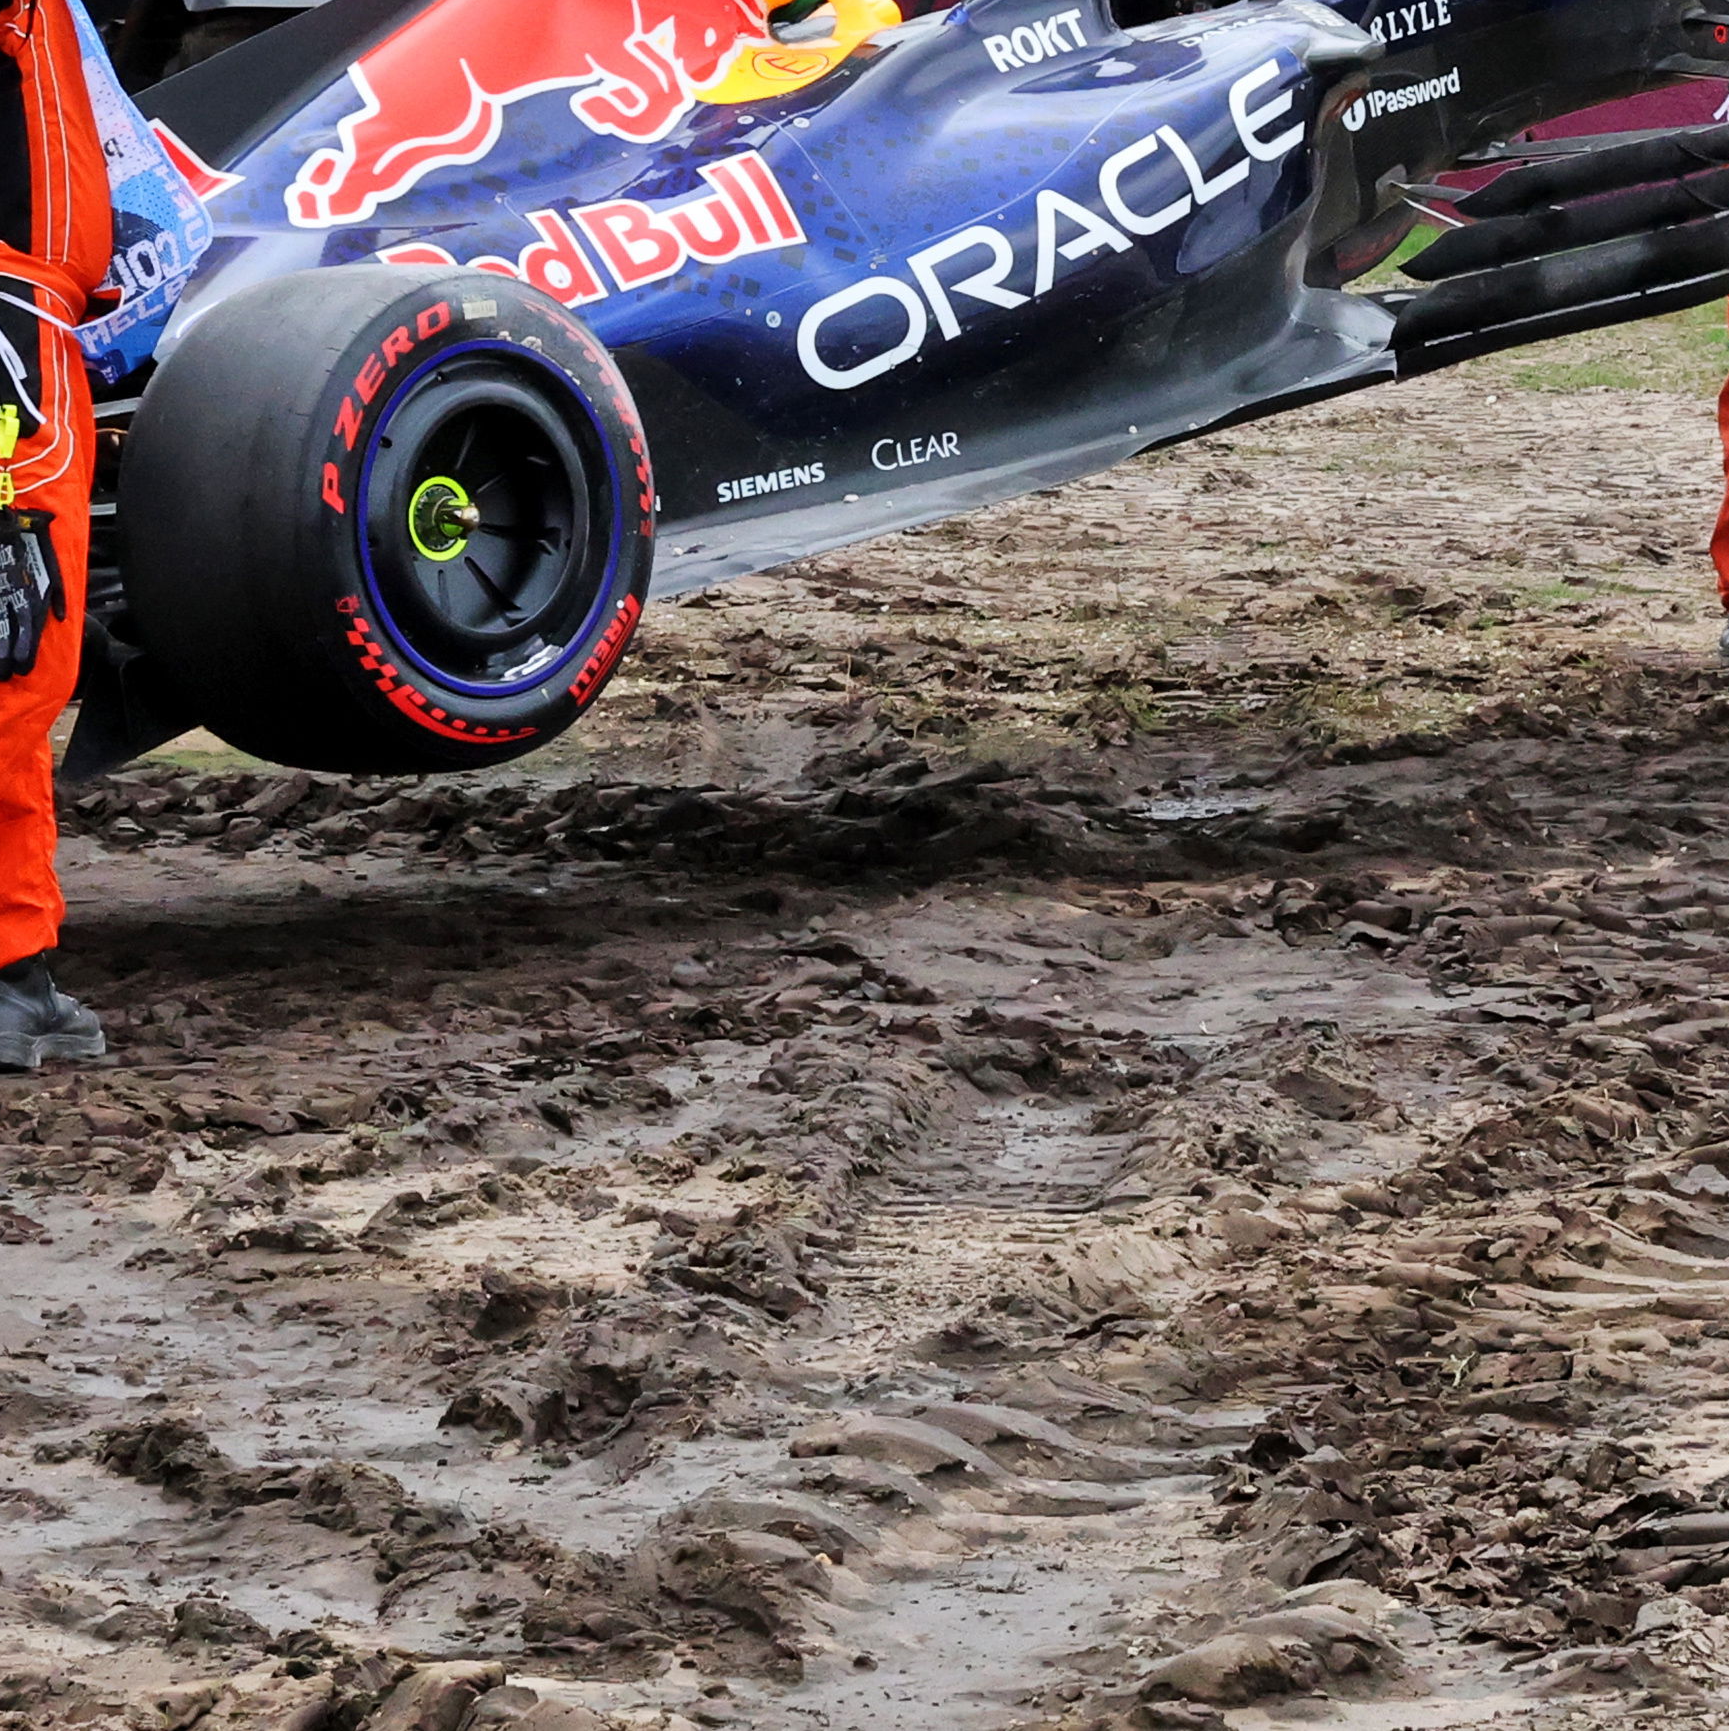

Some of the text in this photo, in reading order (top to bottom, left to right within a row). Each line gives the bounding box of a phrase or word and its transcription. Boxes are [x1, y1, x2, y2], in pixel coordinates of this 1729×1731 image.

[982, 8, 1088, 74] ROKT
[1366, 66, 1461, 118] 1Password
[568, 150, 807, 291] Bull
[797, 58, 1305, 390] ORACLE
[321, 300, 452, 515] P ZERO
[716, 462, 825, 503] SIEMENS
